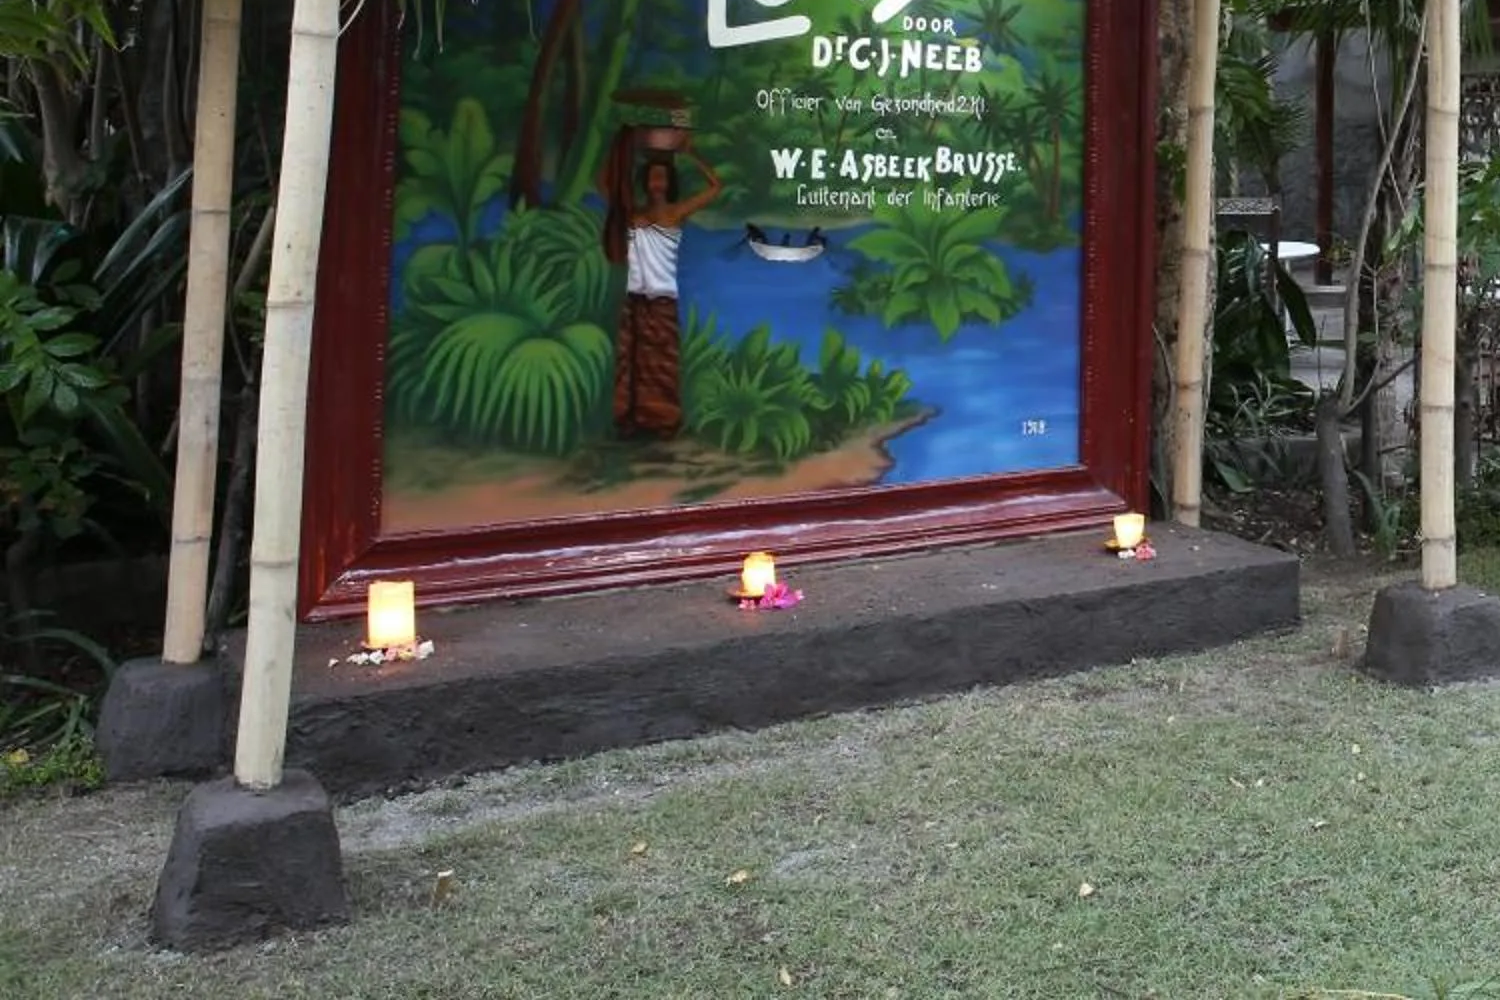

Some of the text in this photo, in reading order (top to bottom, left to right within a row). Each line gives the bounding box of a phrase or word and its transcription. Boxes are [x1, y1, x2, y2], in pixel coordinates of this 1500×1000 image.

[903, 16, 957, 36] DOOR
[756, 87, 824, 117] Officier
[835, 97, 862, 114] van
[887, 188, 913, 206] der
